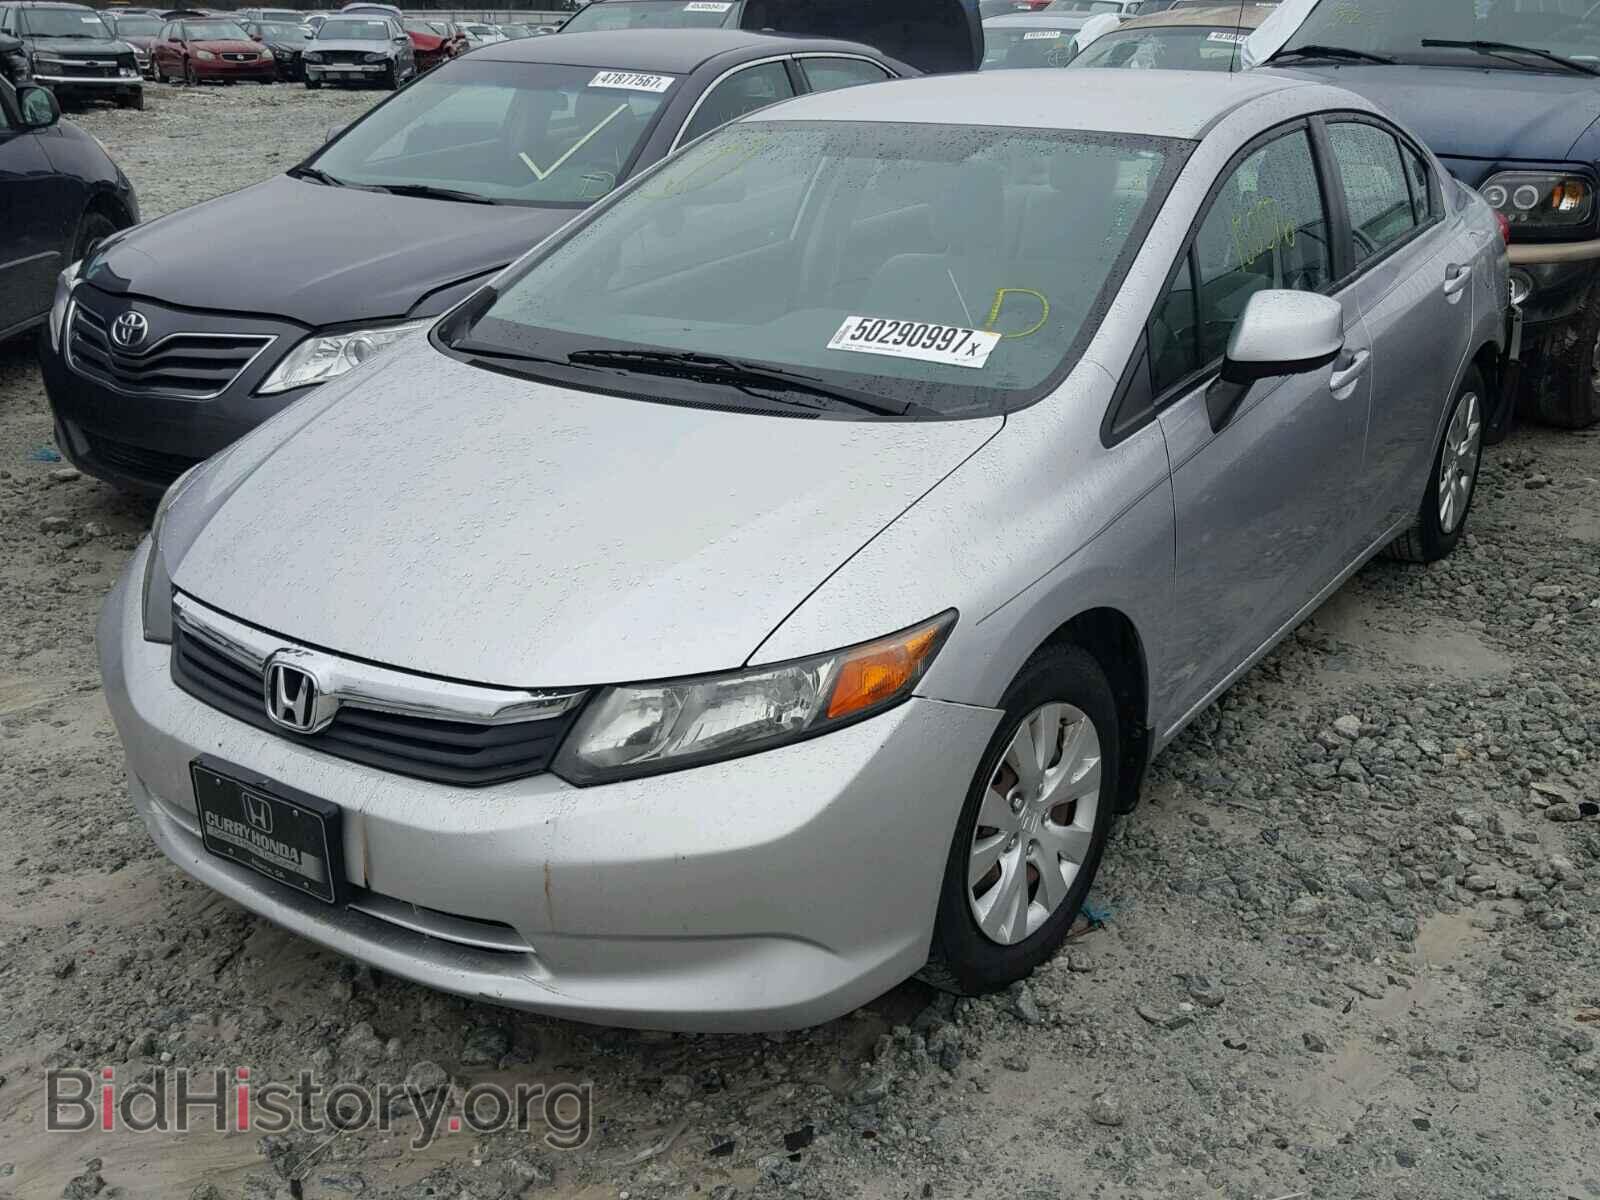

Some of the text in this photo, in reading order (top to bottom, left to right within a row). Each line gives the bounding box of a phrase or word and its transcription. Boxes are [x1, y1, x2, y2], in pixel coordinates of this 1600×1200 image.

[849, 318, 976, 354] 50290997
[205, 811, 251, 839] CURRY
[251, 830, 299, 862] HONDA
